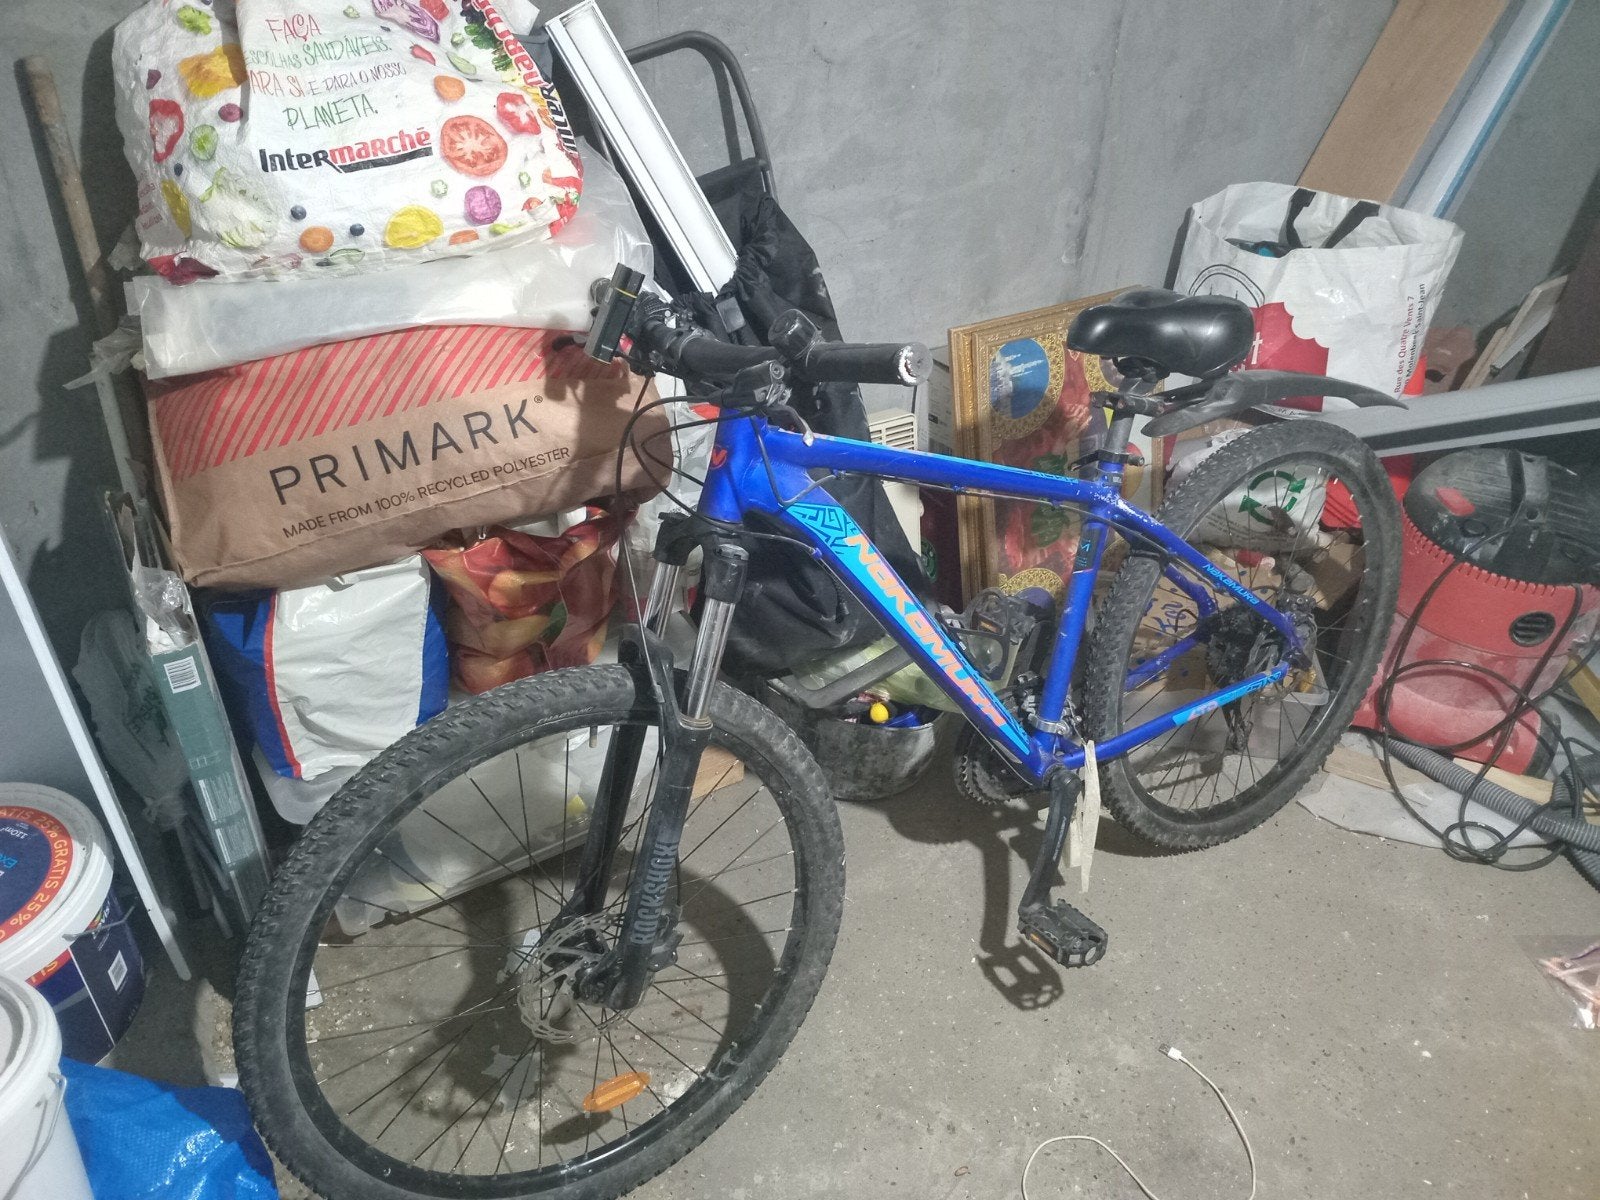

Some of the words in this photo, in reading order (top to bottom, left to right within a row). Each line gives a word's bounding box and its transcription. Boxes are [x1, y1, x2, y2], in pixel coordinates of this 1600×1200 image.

[265, 14, 321, 42] FAÇA
[250, 70, 284, 97] ARA
[308, 80, 322, 96] E
[323, 74, 357, 92] PARA
[359, 71, 369, 84] O
[370, 62, 407, 82] NOSSO
[1403, 302, 1415, 329] Vents
[1398, 329, 1410, 358] Quatre
[269, 399, 538, 506] PRIMARK
[283, 513, 327, 539] MADE
[329, 502, 373, 525] FROM
[375, 491, 416, 511] 100%
[417, 469, 490, 499] RECYCLED
[493, 447, 571, 477] POLYESTER
[0, 809, 34, 820] ATIS
[45, 839, 69, 889] GRATIS
